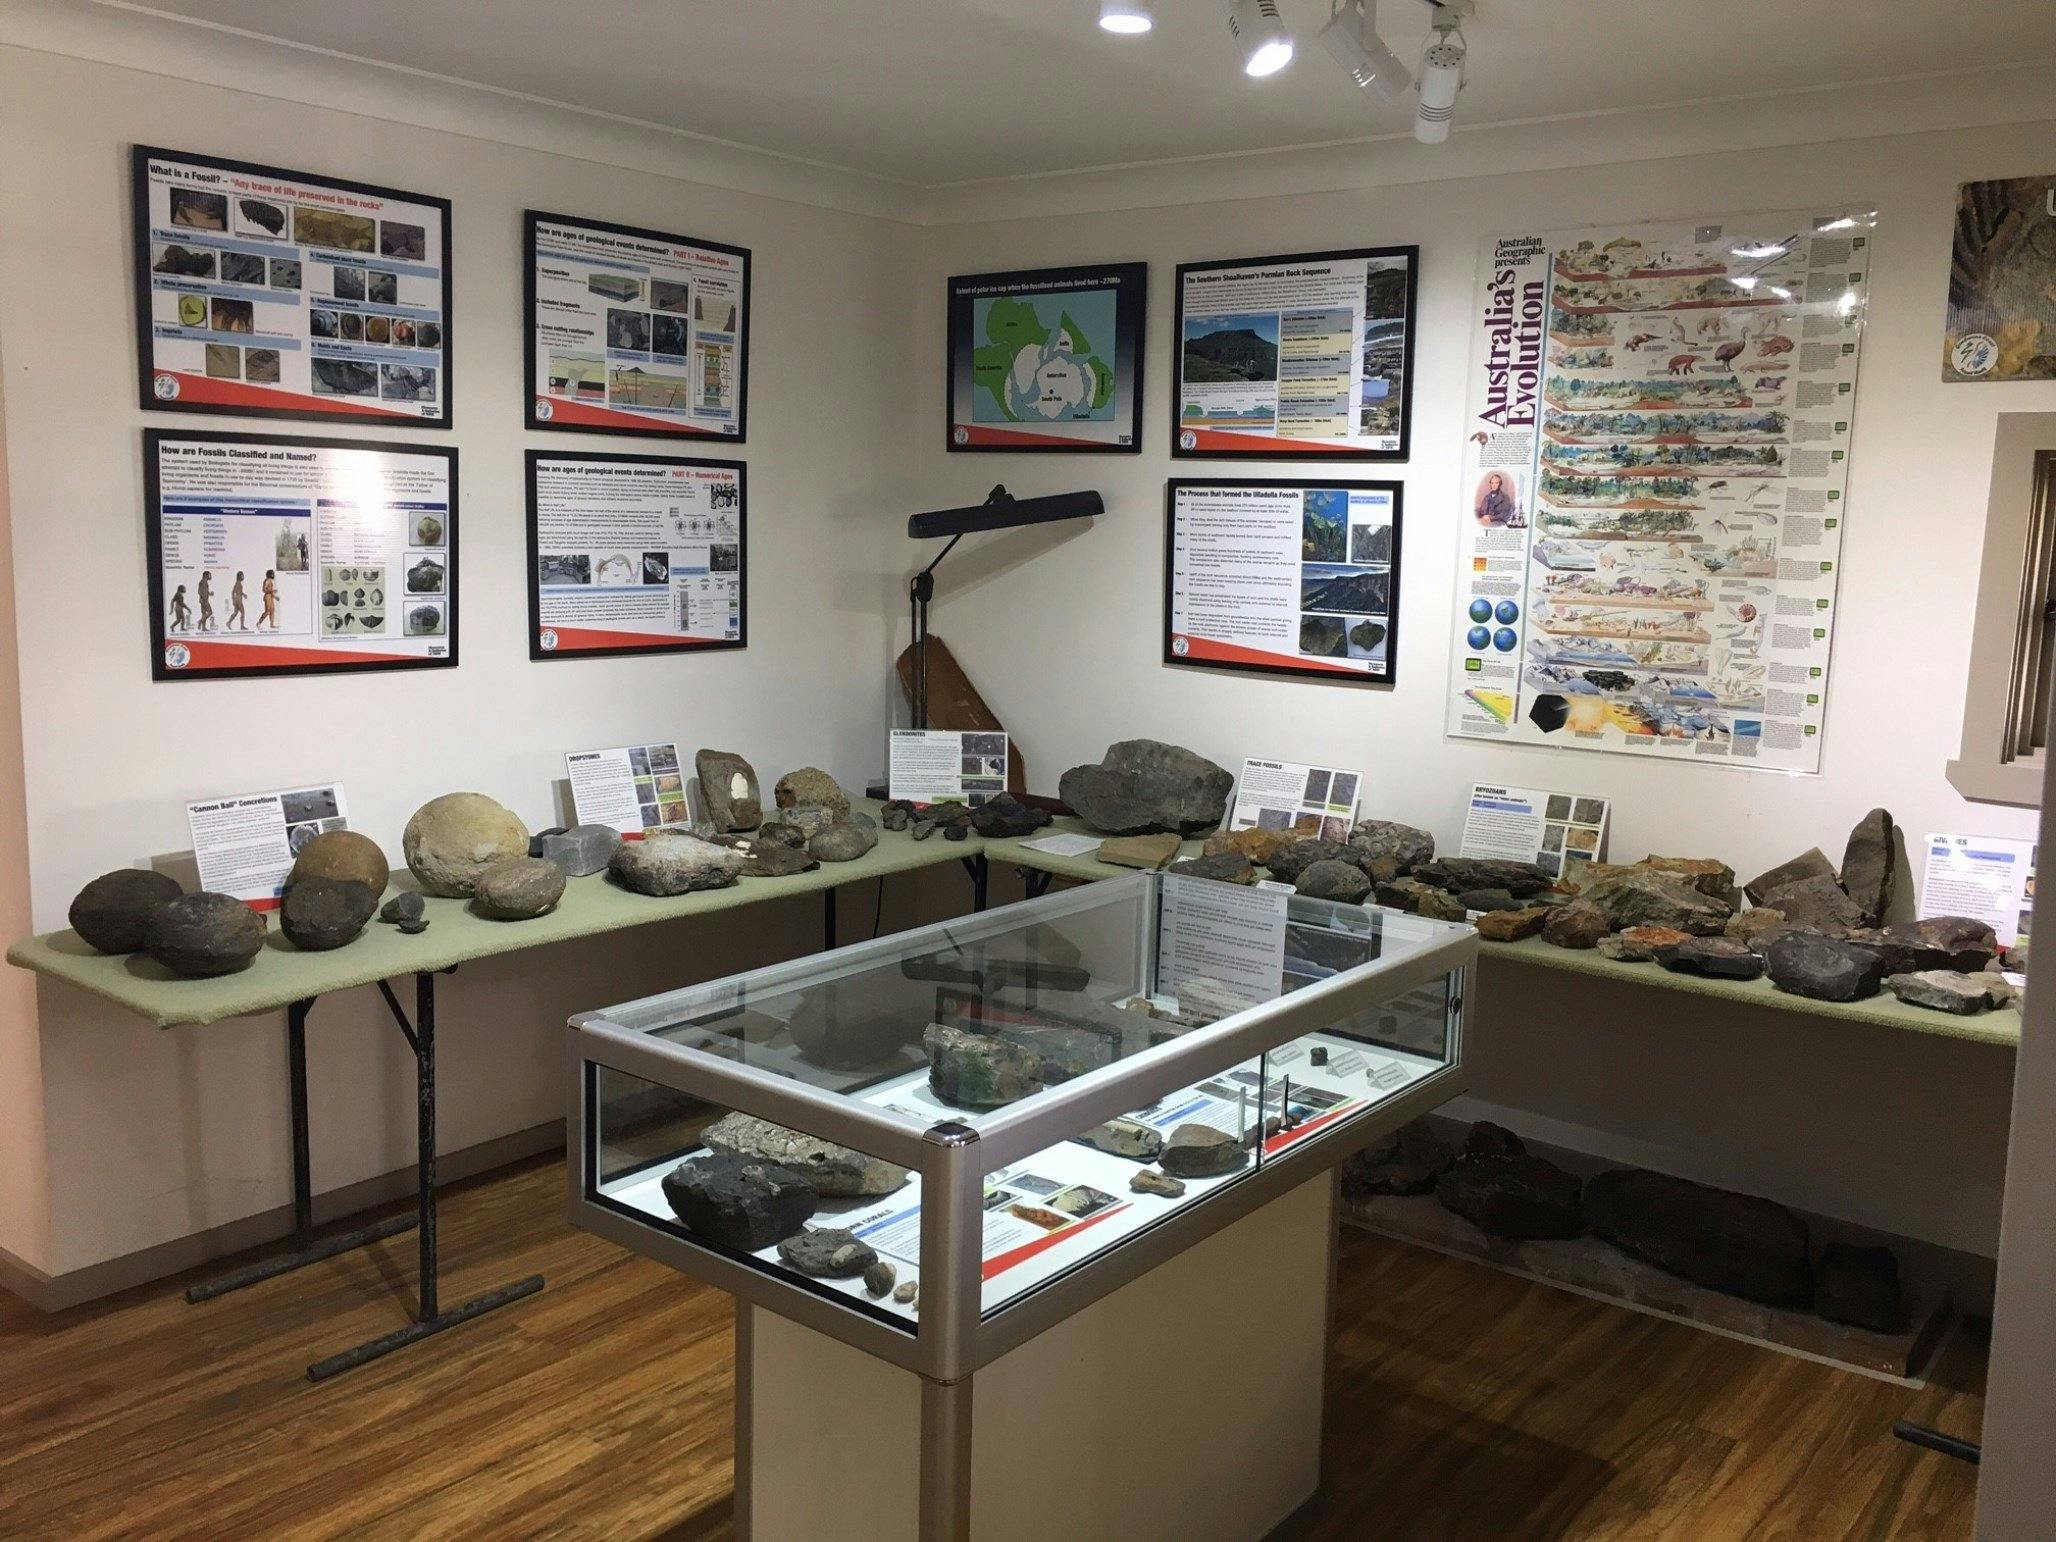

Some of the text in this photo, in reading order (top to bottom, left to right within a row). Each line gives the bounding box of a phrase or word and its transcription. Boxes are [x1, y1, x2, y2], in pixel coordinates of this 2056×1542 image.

[150, 164, 173, 176] What
[174, 168, 182, 177] is
[184, 171, 190, 179] a
[192, 171, 221, 184] Fossil?
[252, 181, 273, 193] trace
[274, 185, 282, 194] of
[284, 186, 297, 197] life
[298, 190, 336, 203] preserved
[337, 196, 345, 205] in
[347, 197, 358, 207] the
[536, 225, 550, 235] How
[552, 229, 562, 238] are
[563, 231, 577, 242] ages
[578, 232, 585, 241] of
[585, 235, 616, 248] geological
[616, 240, 635, 251] events
[635, 241, 670, 256] determined?
[673, 249, 686, 260] PART
[695, 252, 716, 265] Relative
[1497, 236, 1542, 249] Australian
[1494, 246, 1546, 259] Geographic
[1494, 257, 1532, 269] presents
[1186, 267, 1332, 285] The Southern Shoalhaven's Permian Rock Sequence
[956, 287, 971, 295] Extent
[977, 287, 989, 295] polar
[1007, 284, 1021, 292] when
[1054, 281, 1074, 289] animals
[1478, 269, 1516, 429] Australia's
[1507, 281, 1545, 427] Evolution
[161, 446, 317, 462] How are Fossils Classified and Named?
[537, 464, 550, 472] How
[562, 466, 576, 475] ages
[577, 466, 584, 474] of
[585, 467, 614, 476] geological
[633, 469, 667, 477] determined?
[671, 470, 685, 478] PART
[695, 471, 719, 480] Numerical
[720, 472, 734, 481] Ages
[1177, 489, 1187, 497] The
[1188, 490, 1208, 498] Process
[1210, 490, 1221, 498] that
[1222, 490, 1241, 498] formed
[1253, 491, 1278, 499] Ulladulla
[1246, 760, 1283, 770] TRACE FOSSILS
[1475, 787, 1506, 795] BRYOZOANS
[189, 796, 278, 814] "Cannon Ball" Concretions
